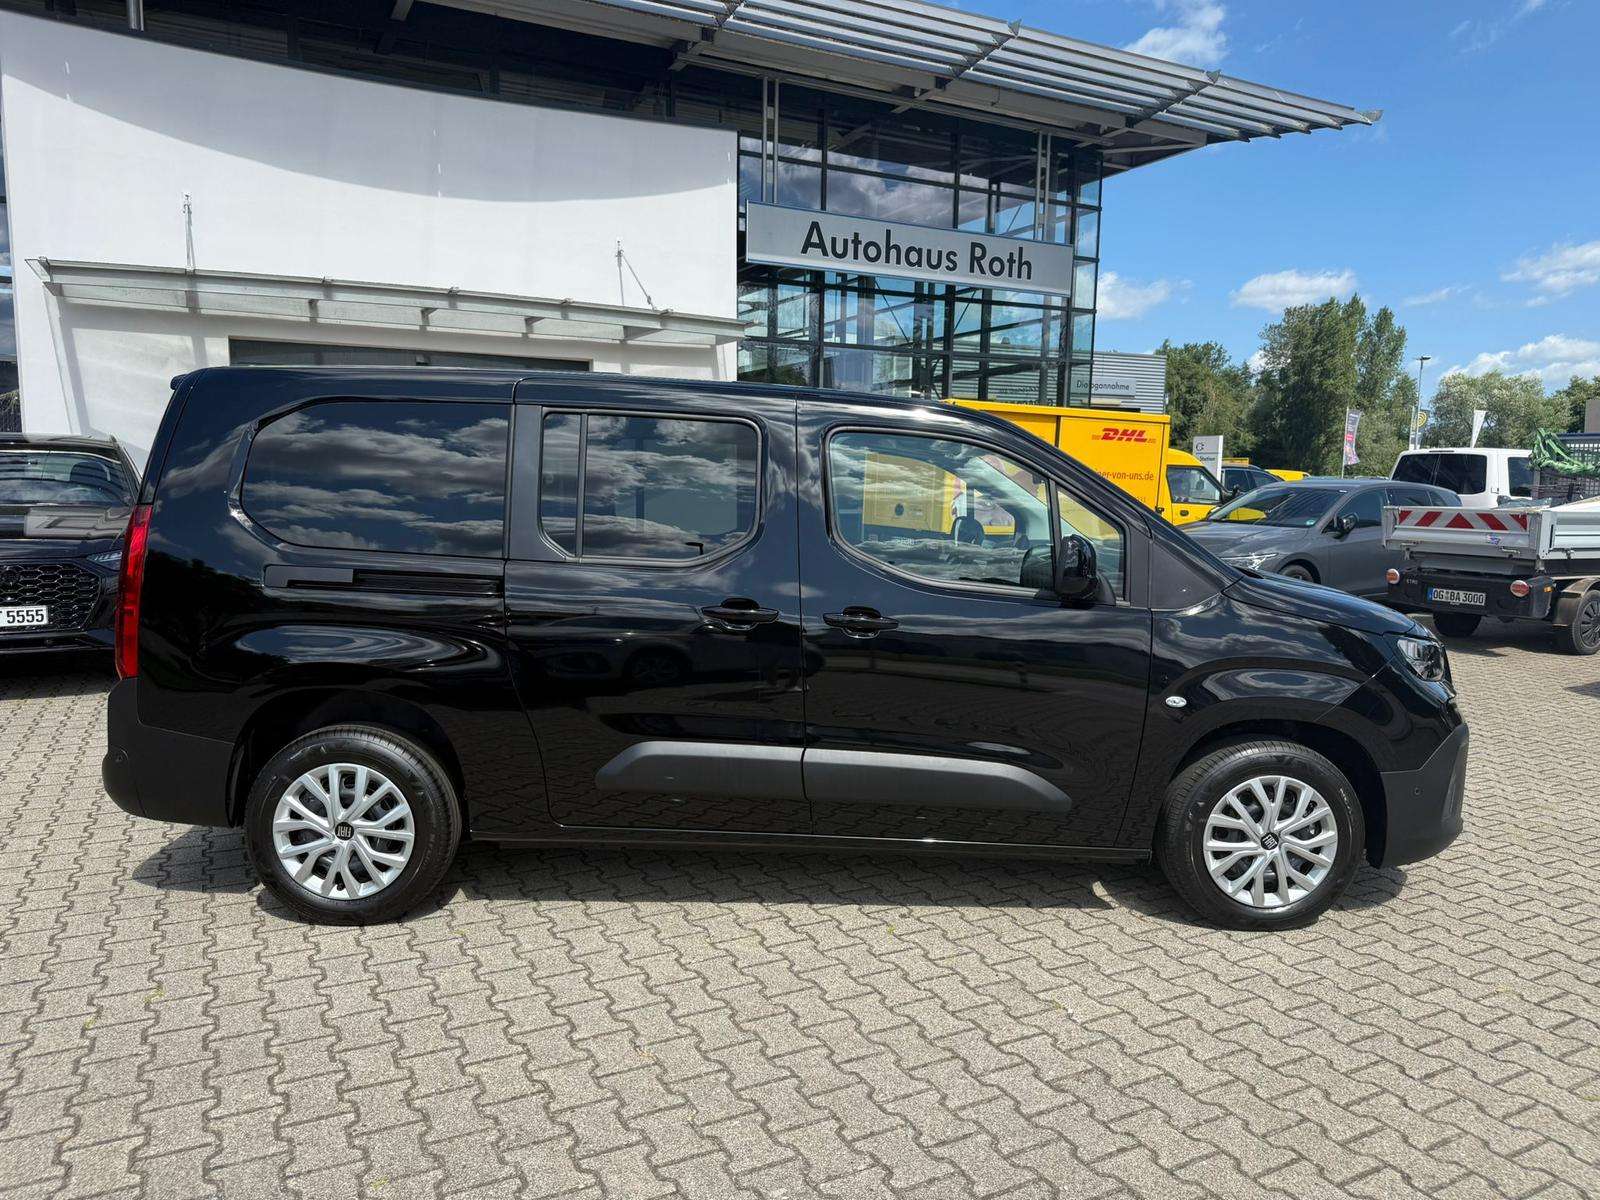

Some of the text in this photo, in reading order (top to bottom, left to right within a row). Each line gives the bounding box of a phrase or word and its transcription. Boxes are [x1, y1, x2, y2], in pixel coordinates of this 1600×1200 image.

[800, 220, 1033, 280] Autohaus Roth
[1076, 379, 1130, 391] Diaogannahme
[1101, 427, 1148, 443] DHL
[1096, 470, 1155, 481] ner-von-uns.de
[1433, 589, 1485, 604] OG BA 3000
[6, 609, 45, 624] 5555
[336, 825, 352, 838] FIAT
[1262, 834, 1278, 850] FIAT
